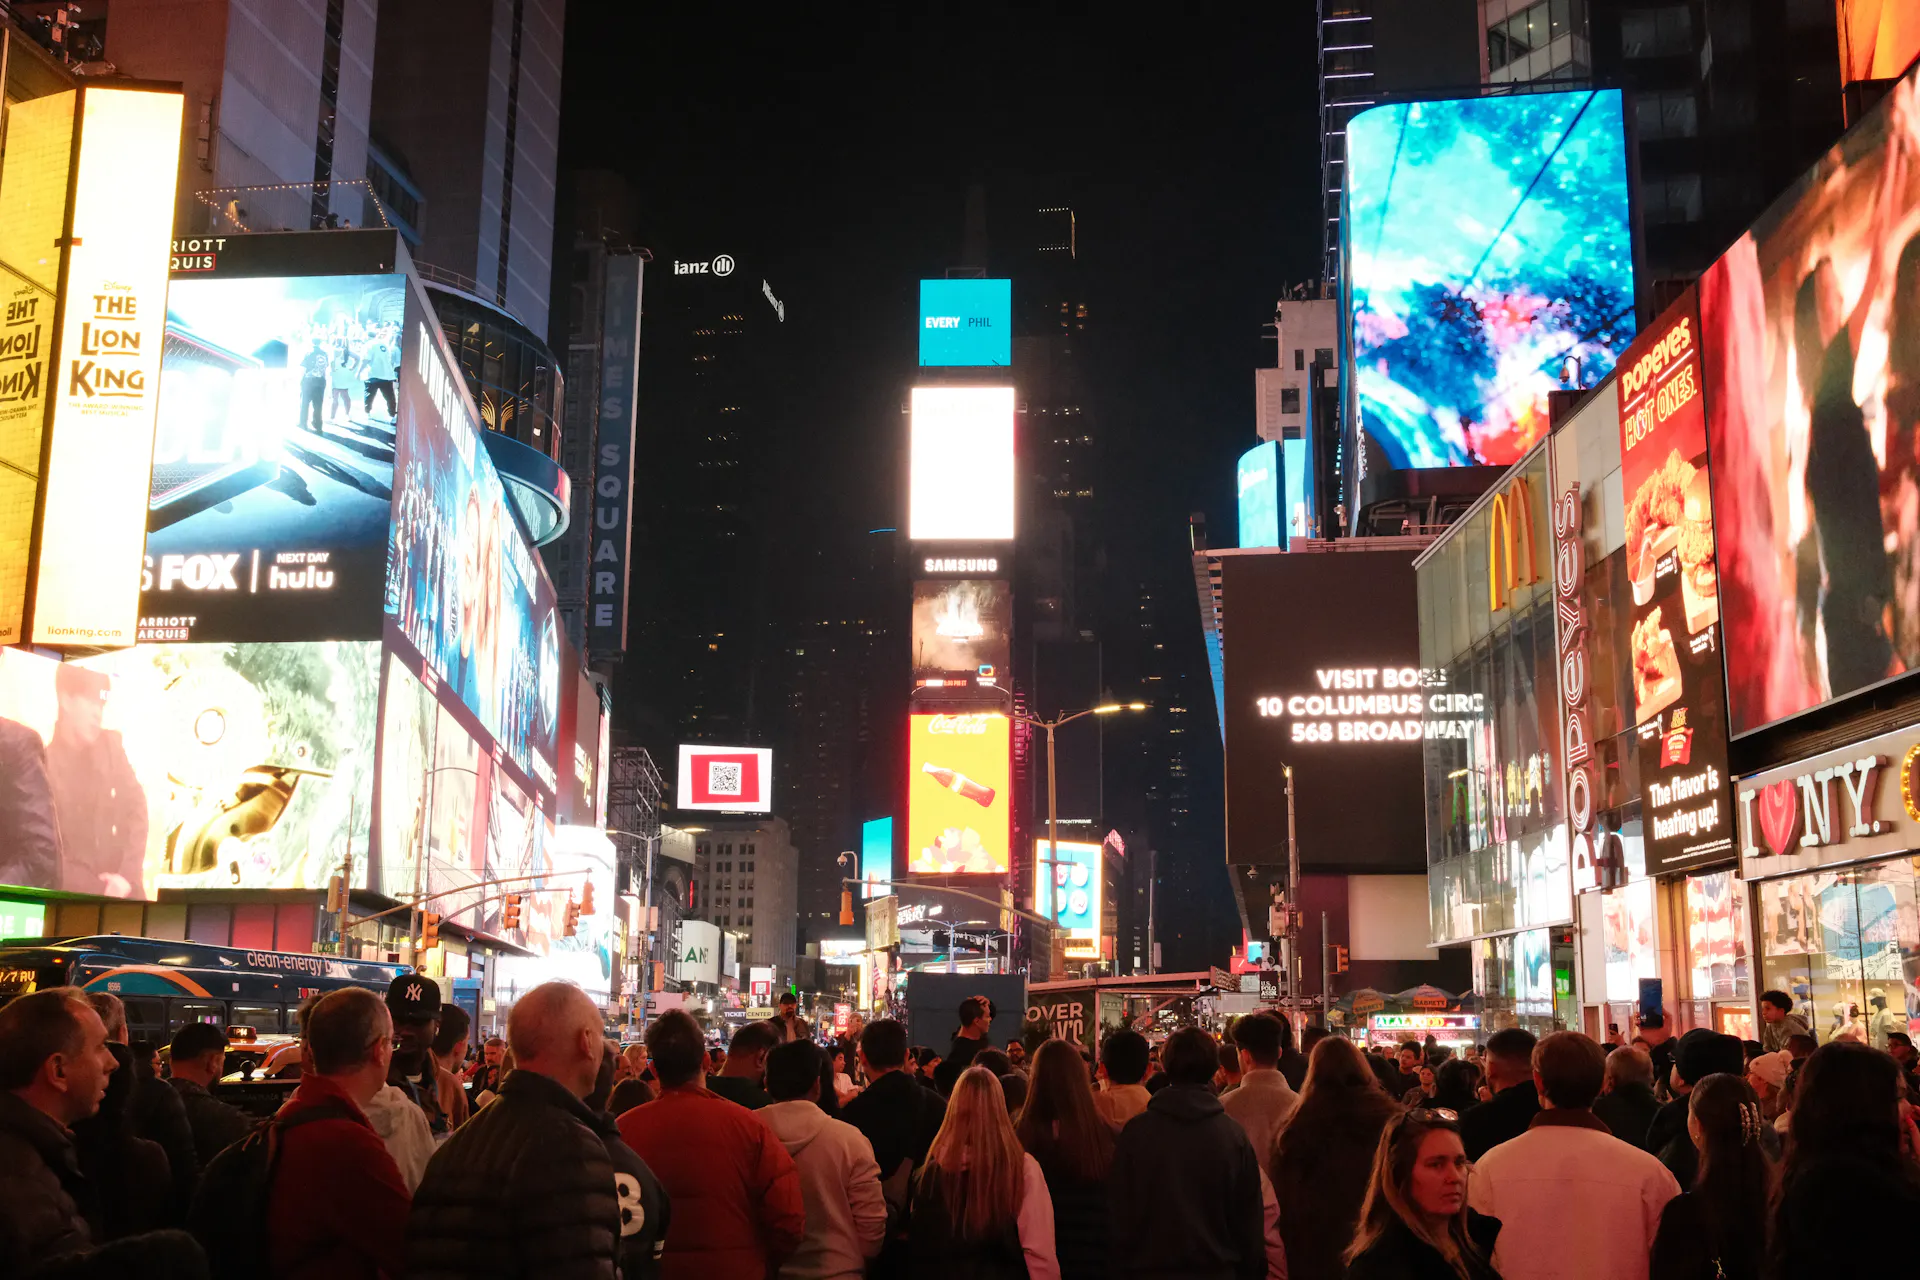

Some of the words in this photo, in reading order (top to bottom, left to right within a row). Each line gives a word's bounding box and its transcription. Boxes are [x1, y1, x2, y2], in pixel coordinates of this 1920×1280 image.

[94, 295, 137, 315] THE
[925, 316, 960, 329] EVERY
[968, 317, 992, 328] PHIL
[81, 322, 141, 356] LION
[69, 360, 144, 398] KING
[594, 444, 622, 628] SQUARE
[277, 552, 305, 563] NEXT
[307, 553, 329, 563] DAY
[924, 558, 998, 573] SAMSUNG
[160, 554, 240, 591] FOX
[269, 566, 334, 589] hulu
[47, 625, 122, 638] lionking.com
[1316, 668, 1378, 690] VISIT
[1257, 697, 1283, 717] 10
[1287, 695, 1422, 716] COLUMBUS
[1291, 723, 1333, 742] 568
[1650, 783, 1671, 808] The
[1672, 774, 1707, 802] flavor
[1708, 765, 1719, 791] is
[1654, 809, 1697, 840] heating
[1698, 799, 1719, 832] up!
[247, 952, 322, 976] clean-energy
[1026, 1002, 1083, 1022] OVER
